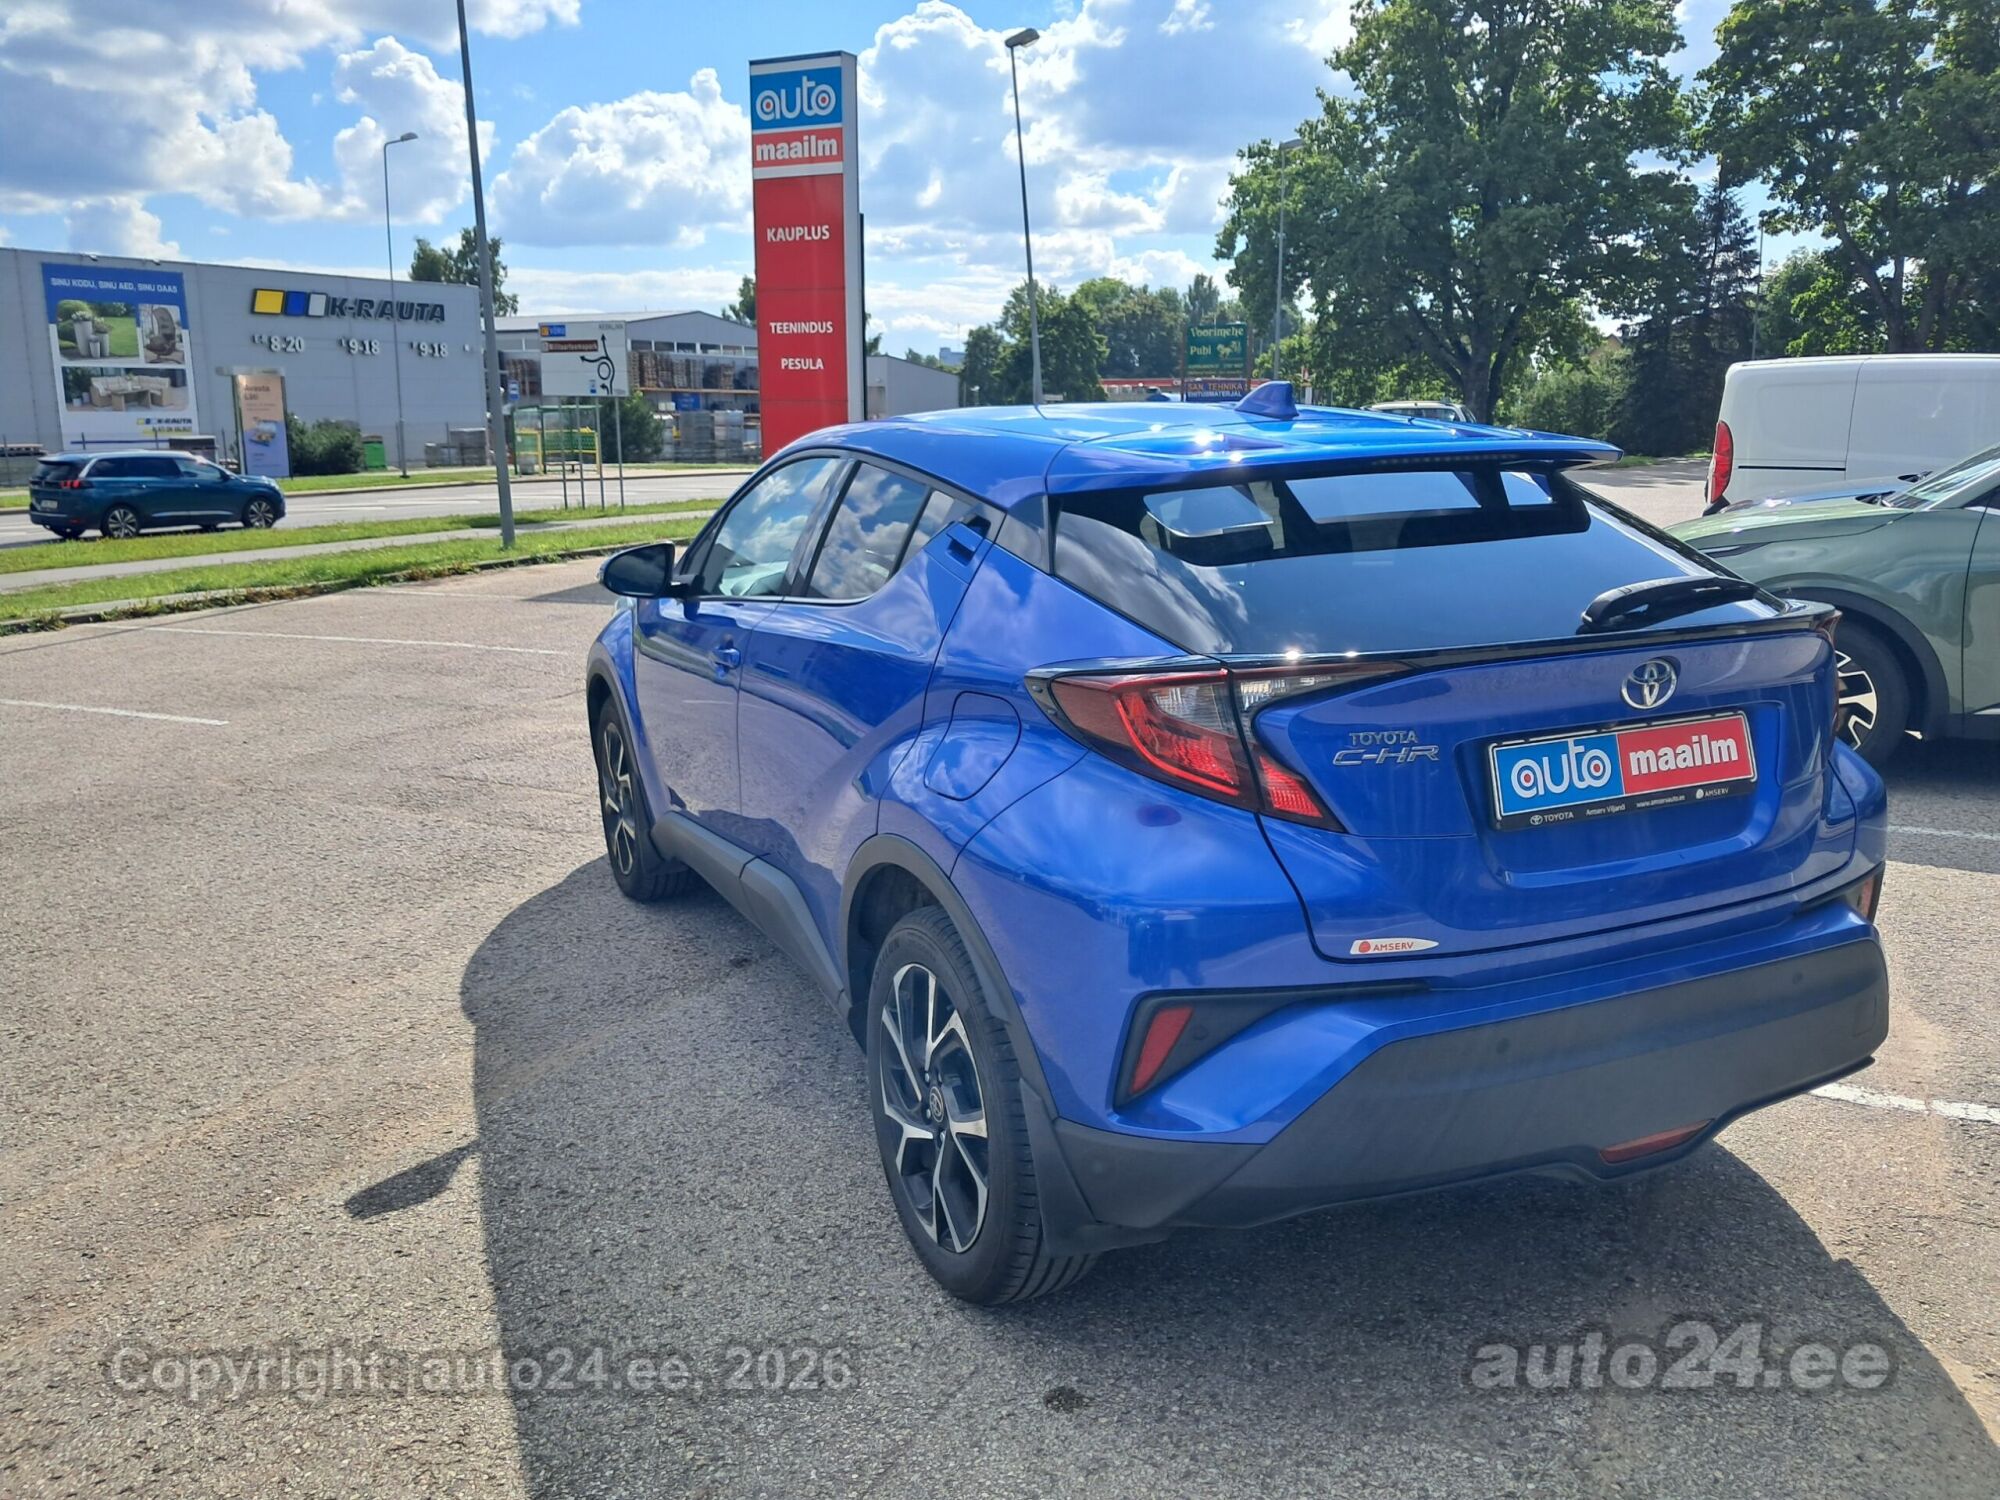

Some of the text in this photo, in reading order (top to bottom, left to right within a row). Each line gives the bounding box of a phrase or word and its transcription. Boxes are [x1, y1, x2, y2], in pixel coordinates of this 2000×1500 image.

[755, 75, 837, 122] auto
[755, 135, 838, 161] maailm
[766, 225, 830, 242] KAUPLUS
[330, 296, 446, 322] K-RAUTA
[769, 321, 834, 334] TEENINDUS
[269, 335, 306, 353] 8-20
[348, 338, 381, 356] 9-18
[419, 342, 449, 359] 9-18
[780, 357, 825, 370] PESULA
[1349, 730, 1418, 746] TOYOTA
[1332, 745, 1440, 766] C-HR
[1510, 734, 1739, 798] auto maailm
[1704, 787, 1730, 799] AMSERV
[1543, 811, 1575, 822] TOYOTA
[1373, 941, 1414, 952] AMSERV
